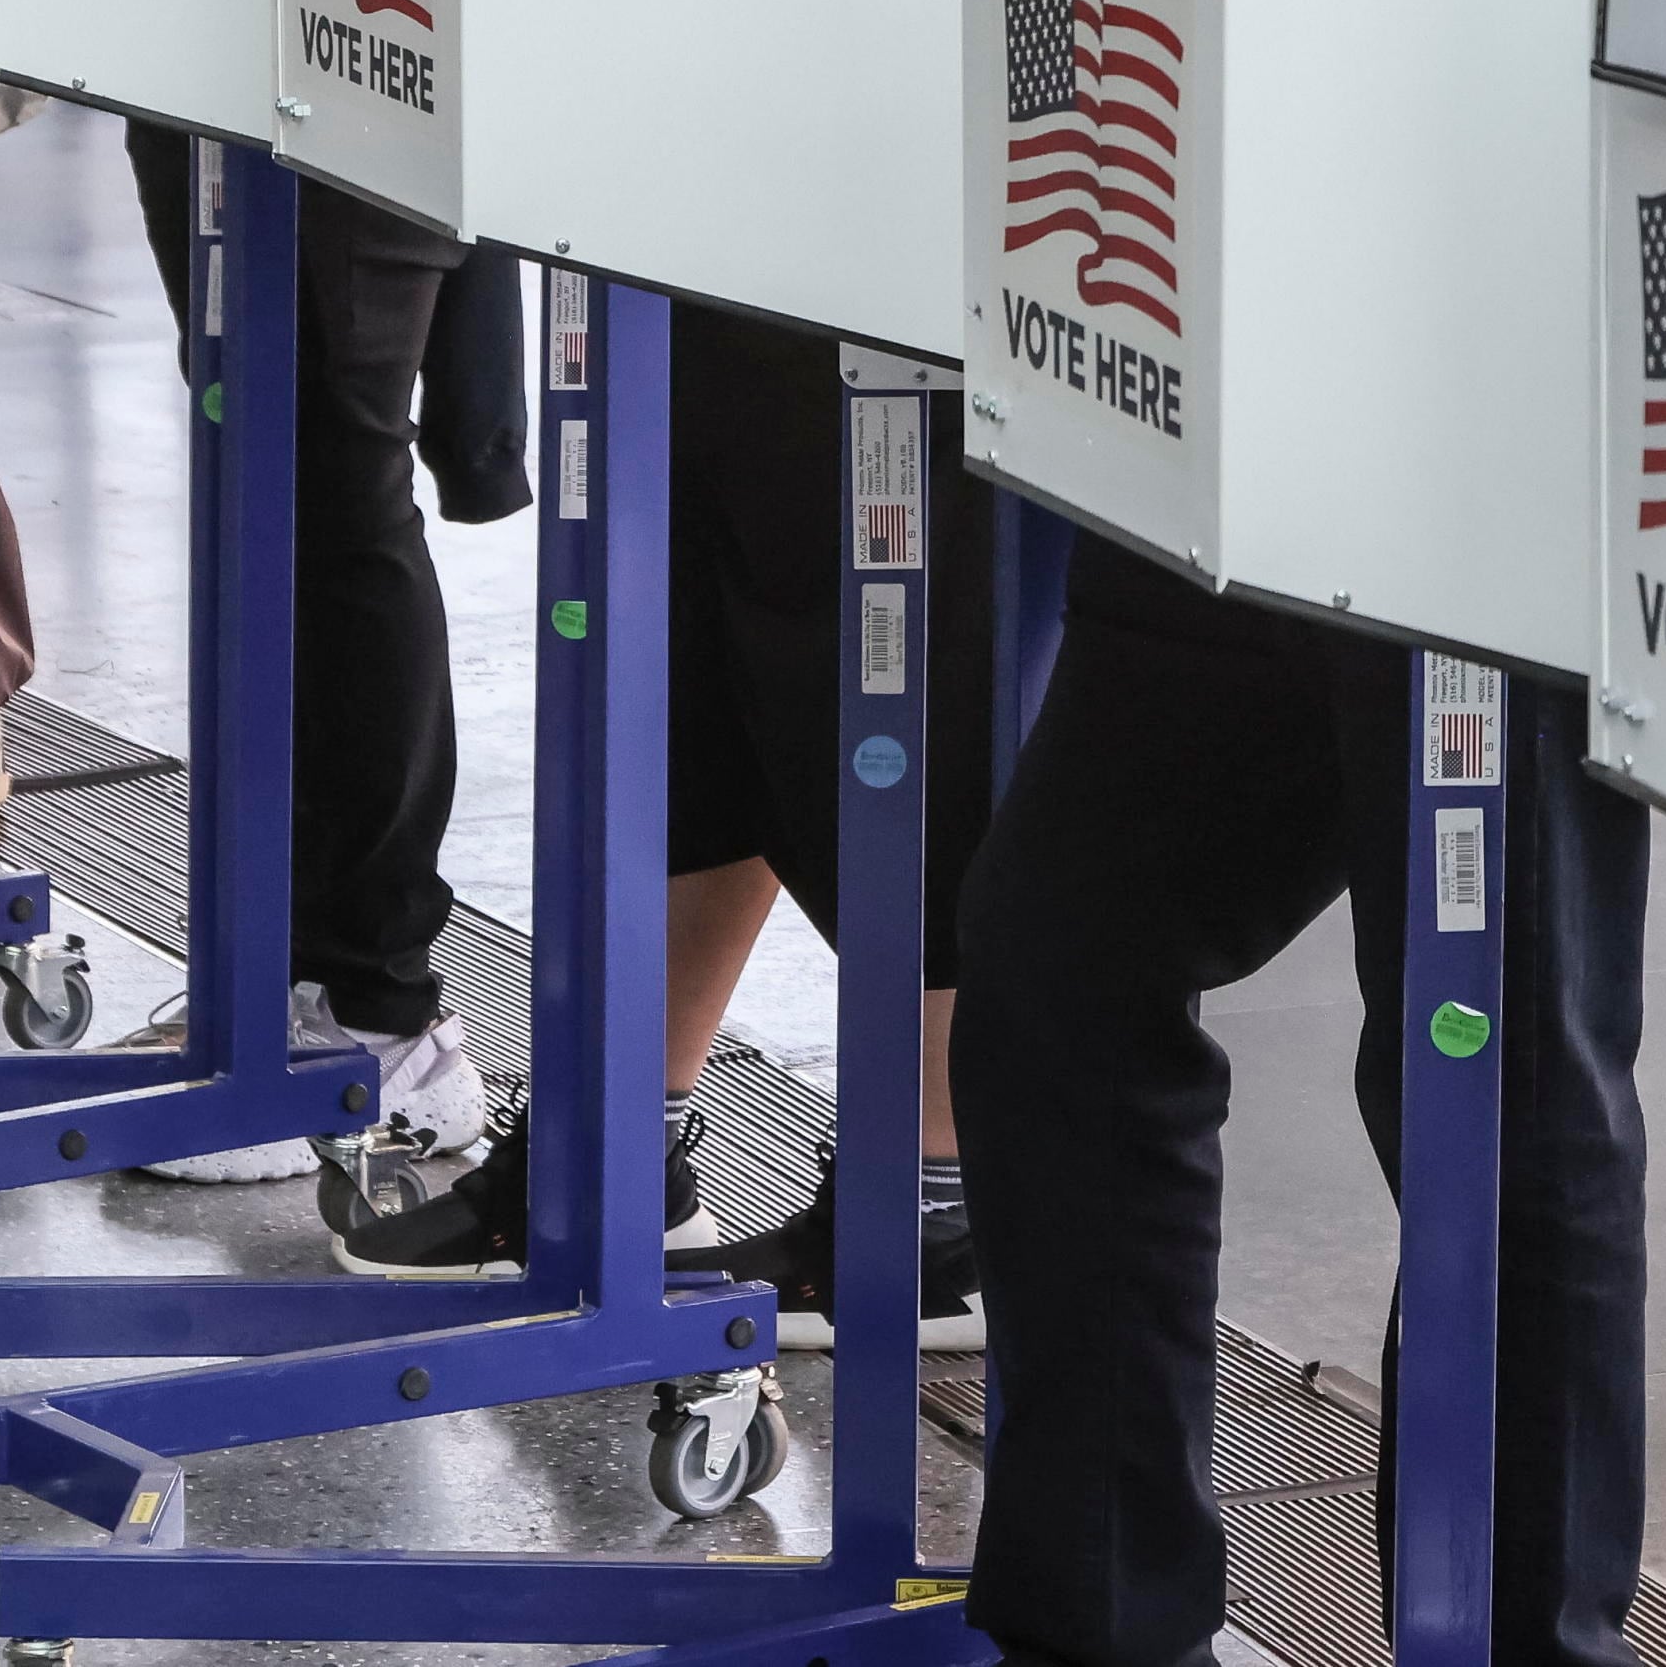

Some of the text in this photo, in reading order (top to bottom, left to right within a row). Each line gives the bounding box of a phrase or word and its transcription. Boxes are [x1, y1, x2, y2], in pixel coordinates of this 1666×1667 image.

[300, 7, 434, 114] VOTE HERE
[1002, 287, 1182, 439] VOTE HERE
[859, 504, 867, 563] MADE IN
[1430, 713, 1439, 779] MADE IN
